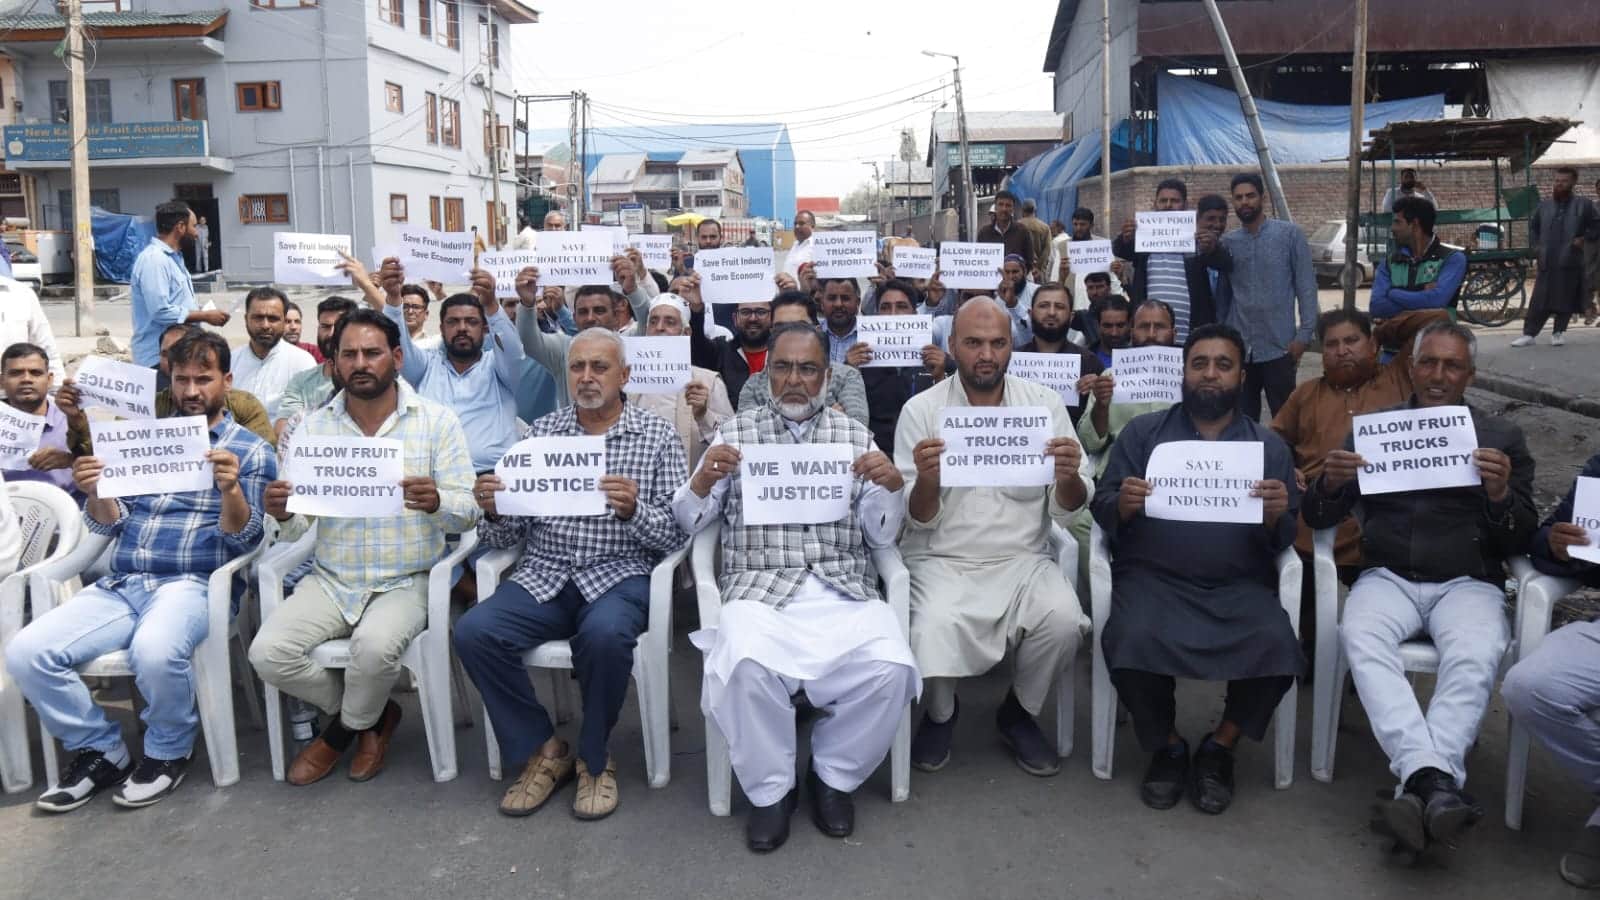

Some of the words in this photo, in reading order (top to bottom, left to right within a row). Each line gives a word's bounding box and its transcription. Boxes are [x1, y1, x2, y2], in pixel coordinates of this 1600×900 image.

[25, 128, 50, 136] New
[104, 126, 128, 136] Fruit
[135, 124, 199, 134] Association
[1167, 216, 1194, 224] POOR
[1152, 228, 1180, 236] FRUIT
[279, 242, 297, 250] Save
[299, 242, 316, 250] Fruit
[403, 233, 420, 243] Save
[422, 236, 440, 248] Fruit
[440, 240, 472, 252] Industry
[1142, 240, 1192, 248] GROWERS
[562, 244, 584, 252] SAVE
[942, 248, 972, 256] ALLOW
[288, 256, 306, 264] Save
[412, 249, 428, 259] Save
[431, 252, 464, 265] Economy
[484, 256, 530, 264] ROWERS
[702, 258, 720, 268] Save
[722, 257, 739, 266] Fruit
[741, 256, 772, 267] Industry
[1073, 256, 1108, 264] JUSTICE
[898, 262, 931, 270] JUSTICE
[550, 268, 598, 276] INDUSTRY
[710, 272, 728, 282] Save
[730, 272, 764, 281] Economy
[958, 270, 999, 278] PRIORITY
[861, 321, 892, 331] SAVE
[896, 321, 928, 330] POOR
[877, 336, 912, 344] FRUIT
[636, 350, 664, 358] SAVE
[1120, 354, 1154, 364] ALLOW
[1158, 354, 1182, 363] FRUI
[632, 363, 689, 372] TICULTURE
[1115, 367, 1148, 376] LADEN
[1152, 366, 1184, 376] TRUCK
[630, 376, 676, 385] NDUSTRY
[1042, 372, 1078, 380] TRUCKS
[79, 372, 144, 396] JUSTICE
[1130, 390, 1175, 400] PRIORITY
[126, 402, 150, 416] WE
[944, 417, 998, 428] ALLOW
[1003, 416, 1048, 428] FRUIT
[1358, 420, 1412, 436] ALLOW
[1418, 416, 1466, 430] FRUIT
[97, 430, 152, 442] ALLOW
[156, 426, 202, 438] FRUIT
[964, 436, 1029, 447] TRUCKS
[1380, 436, 1448, 453] TRUCKS
[120, 444, 184, 458] TRUCKS
[294, 446, 348, 458] ALLOW
[352, 448, 398, 458] FRUIT
[503, 454, 532, 468] WE
[544, 452, 602, 467] WANT
[946, 455, 968, 466] ON
[974, 454, 1046, 465] PRIORITY
[1186, 460, 1224, 470] SAVE
[1363, 462, 1387, 474] ON
[1392, 454, 1471, 471] PRIORITY
[104, 467, 127, 478] ON
[132, 461, 205, 476] PRIORITY
[314, 466, 378, 478] TRUCKS
[748, 462, 779, 476] WE
[791, 461, 850, 475] WANT
[296, 484, 318, 496] ON
[322, 485, 396, 496] PRIORITY
[510, 478, 594, 492] JUSTICE
[758, 486, 843, 500] JUSTICE
[1168, 496, 1240, 508] INDUSTRY
